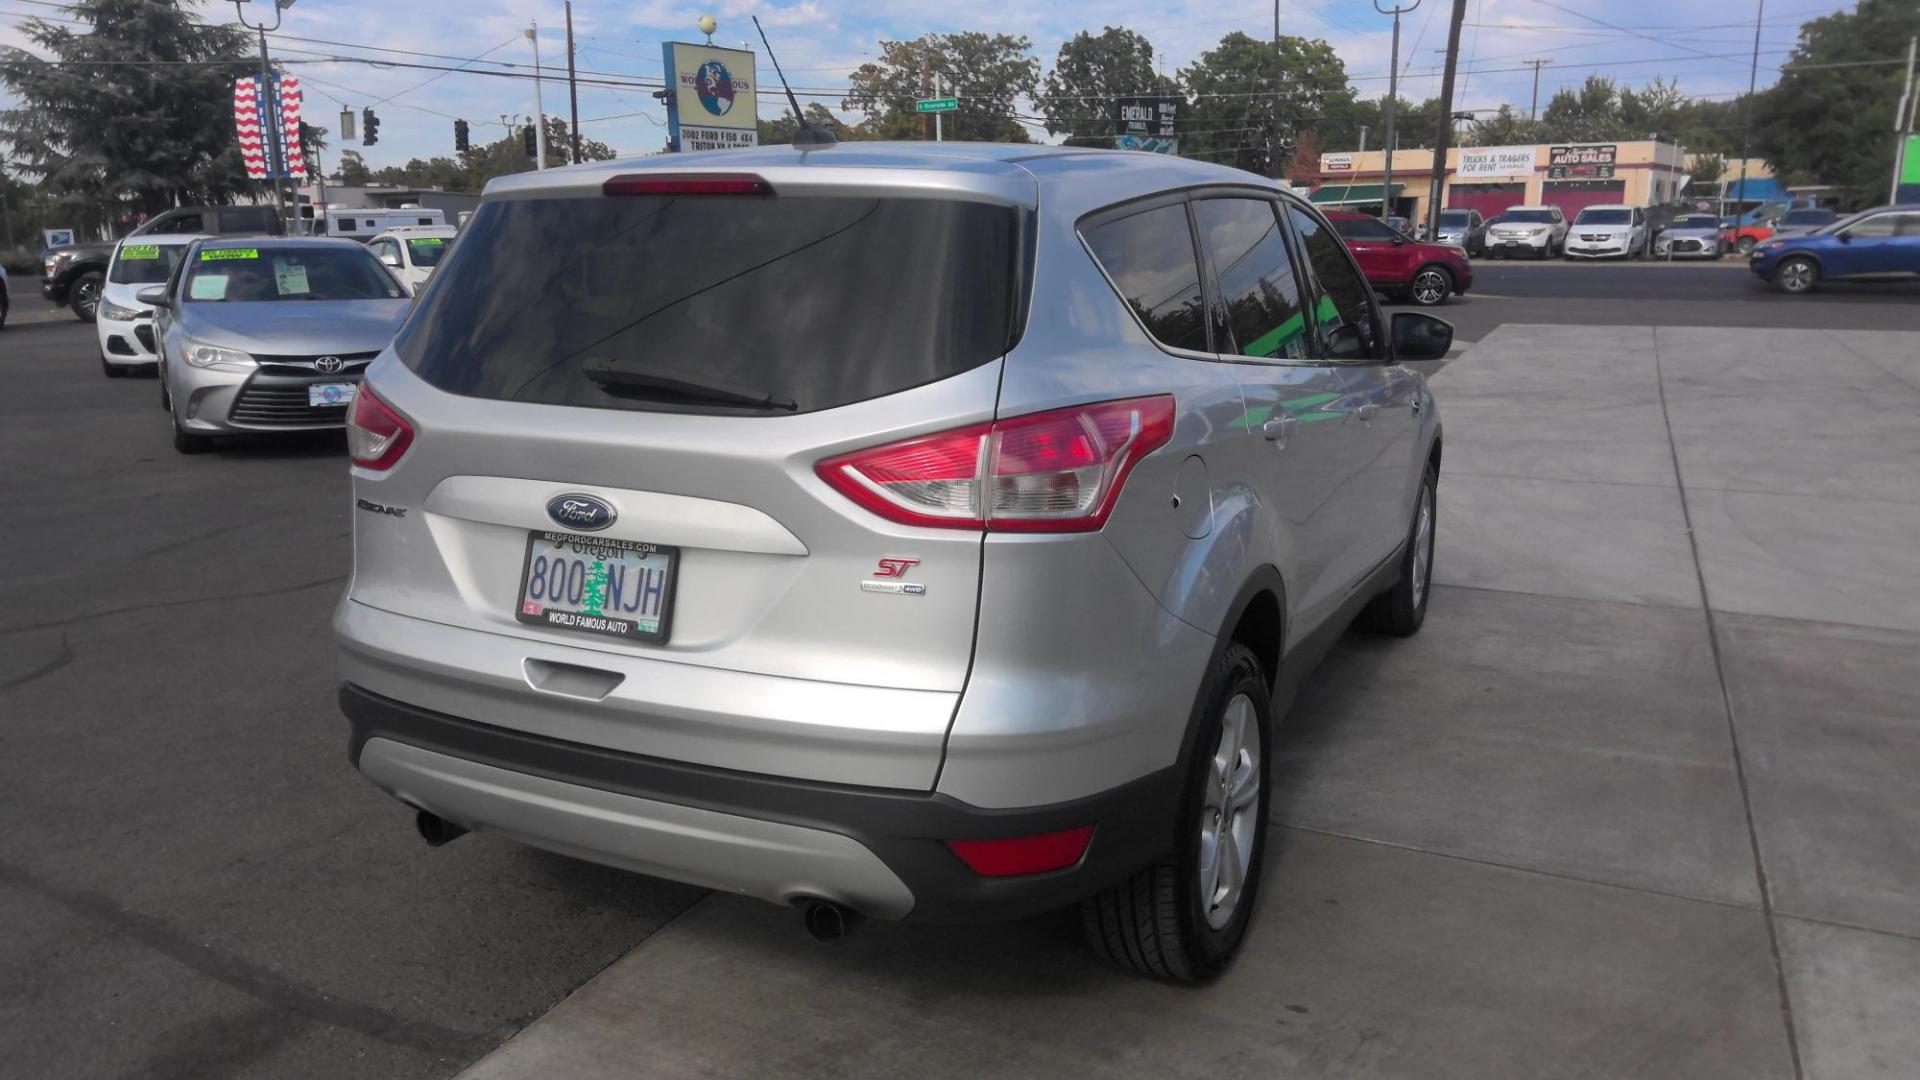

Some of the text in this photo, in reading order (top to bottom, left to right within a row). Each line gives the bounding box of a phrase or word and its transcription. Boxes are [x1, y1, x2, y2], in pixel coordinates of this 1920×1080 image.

[255, 83, 262, 101] WE
[273, 82, 280, 100] WE
[1121, 105, 1153, 121] EMERALD
[259, 107, 272, 172] FINANCE
[277, 106, 287, 171] FINANCE
[682, 129, 699, 140] 2002
[701, 131, 718, 141] FORD
[740, 133, 753, 143] 4X4
[691, 141, 715, 151] TRITON
[1462, 163, 1497, 172] FOR RENT
[1463, 155, 1487, 164] TRUCKS
[1553, 153, 1612, 164] AUTO SALES
[558, 500, 598, 522] Ford
[544, 532, 657, 553] MEDFORDCARSALES.COM
[571, 542, 626, 561] Oregon
[873, 558, 921, 578] ST
[530, 555, 664, 616] 800 NJH
[549, 612, 576, 626] WORLD
[575, 616, 606, 631] FAMOUS
[606, 621, 628, 634] AUTO
